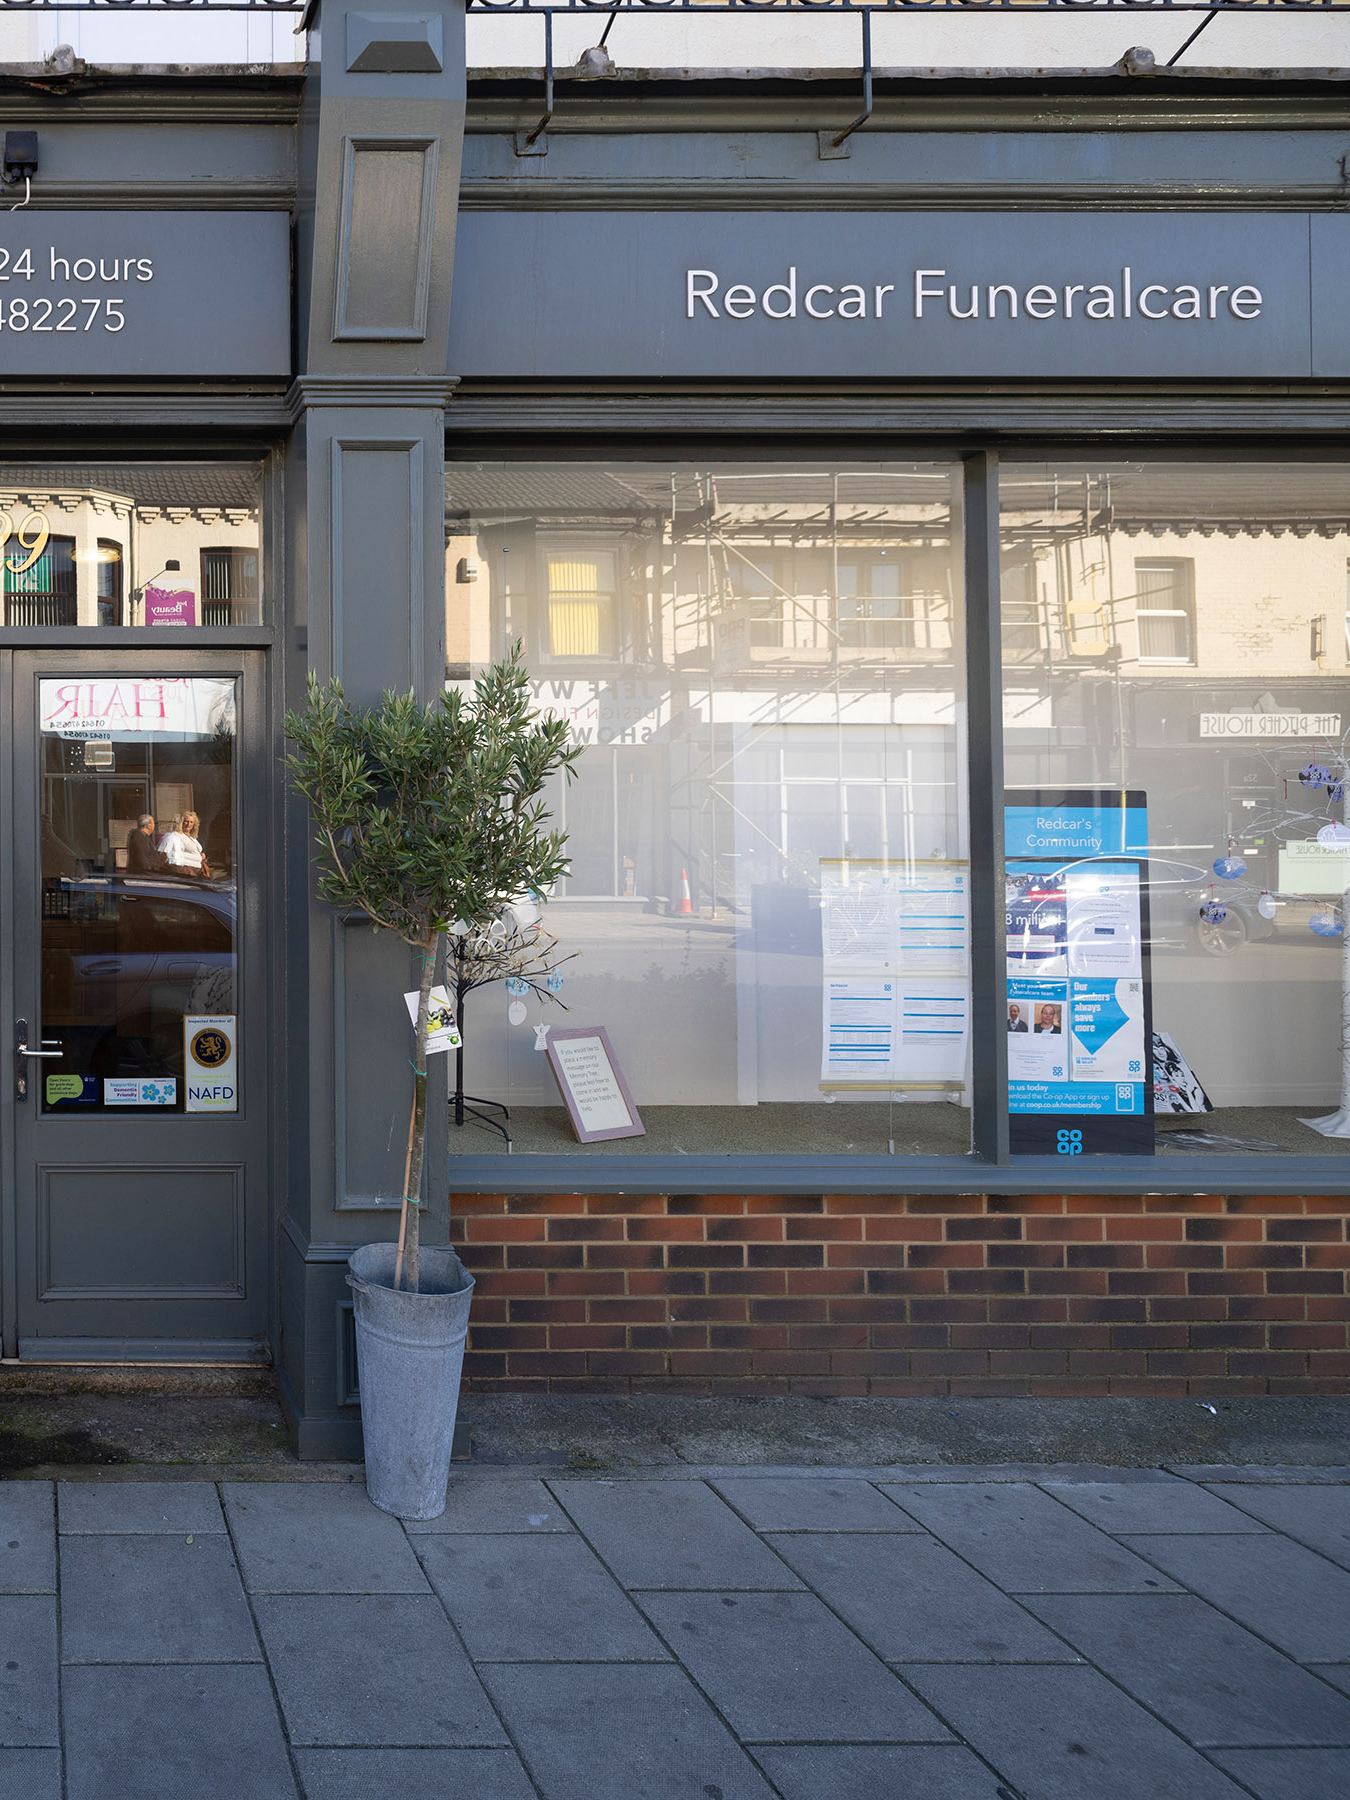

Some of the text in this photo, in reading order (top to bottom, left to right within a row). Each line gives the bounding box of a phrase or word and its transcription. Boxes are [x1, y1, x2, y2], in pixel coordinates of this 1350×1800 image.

[50, 246, 154, 281] hours
[686, 266, 1262, 320] Redcar Funeralcare
[1037, 818, 1092, 829] Redcar's
[1026, 835, 1102, 850] Community
[1074, 982, 1088, 990] Our
[1074, 992, 1110, 1001] members
[1075, 1003, 1101, 1012] always
[1075, 1014, 1093, 1022] save
[1075, 1024, 1095, 1032] more
[1027, 1084, 1048, 1092] today
[189, 1087, 234, 1100] NAFD
[1065, 1094, 1078, 1102] App
[1087, 1094, 1099, 1102] sign
